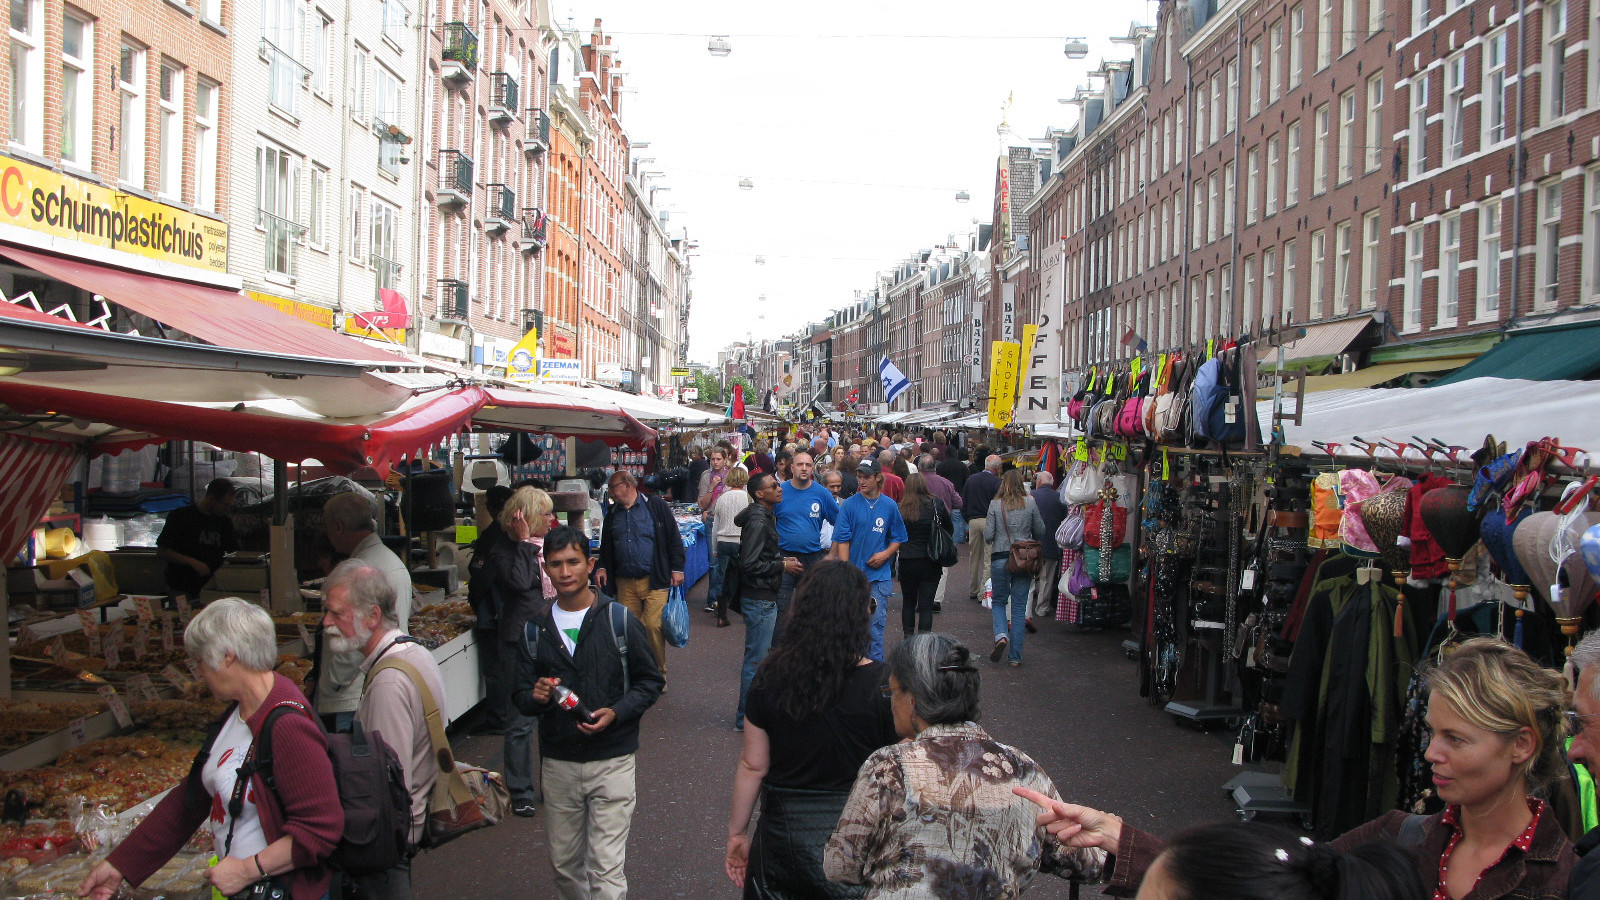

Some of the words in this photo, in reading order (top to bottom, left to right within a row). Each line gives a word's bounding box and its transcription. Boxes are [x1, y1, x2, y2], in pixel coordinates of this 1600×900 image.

[1, 166, 24, 217] C
[31, 185, 203, 260] schuimplastichuis
[1000, 168, 1009, 213] CAFE
[542, 361, 580, 369] ZEEMAN
[973, 318, 982, 366] BAZAR
[1003, 350, 1013, 400] SNOEP
[199, 530, 221, 546] AIR
